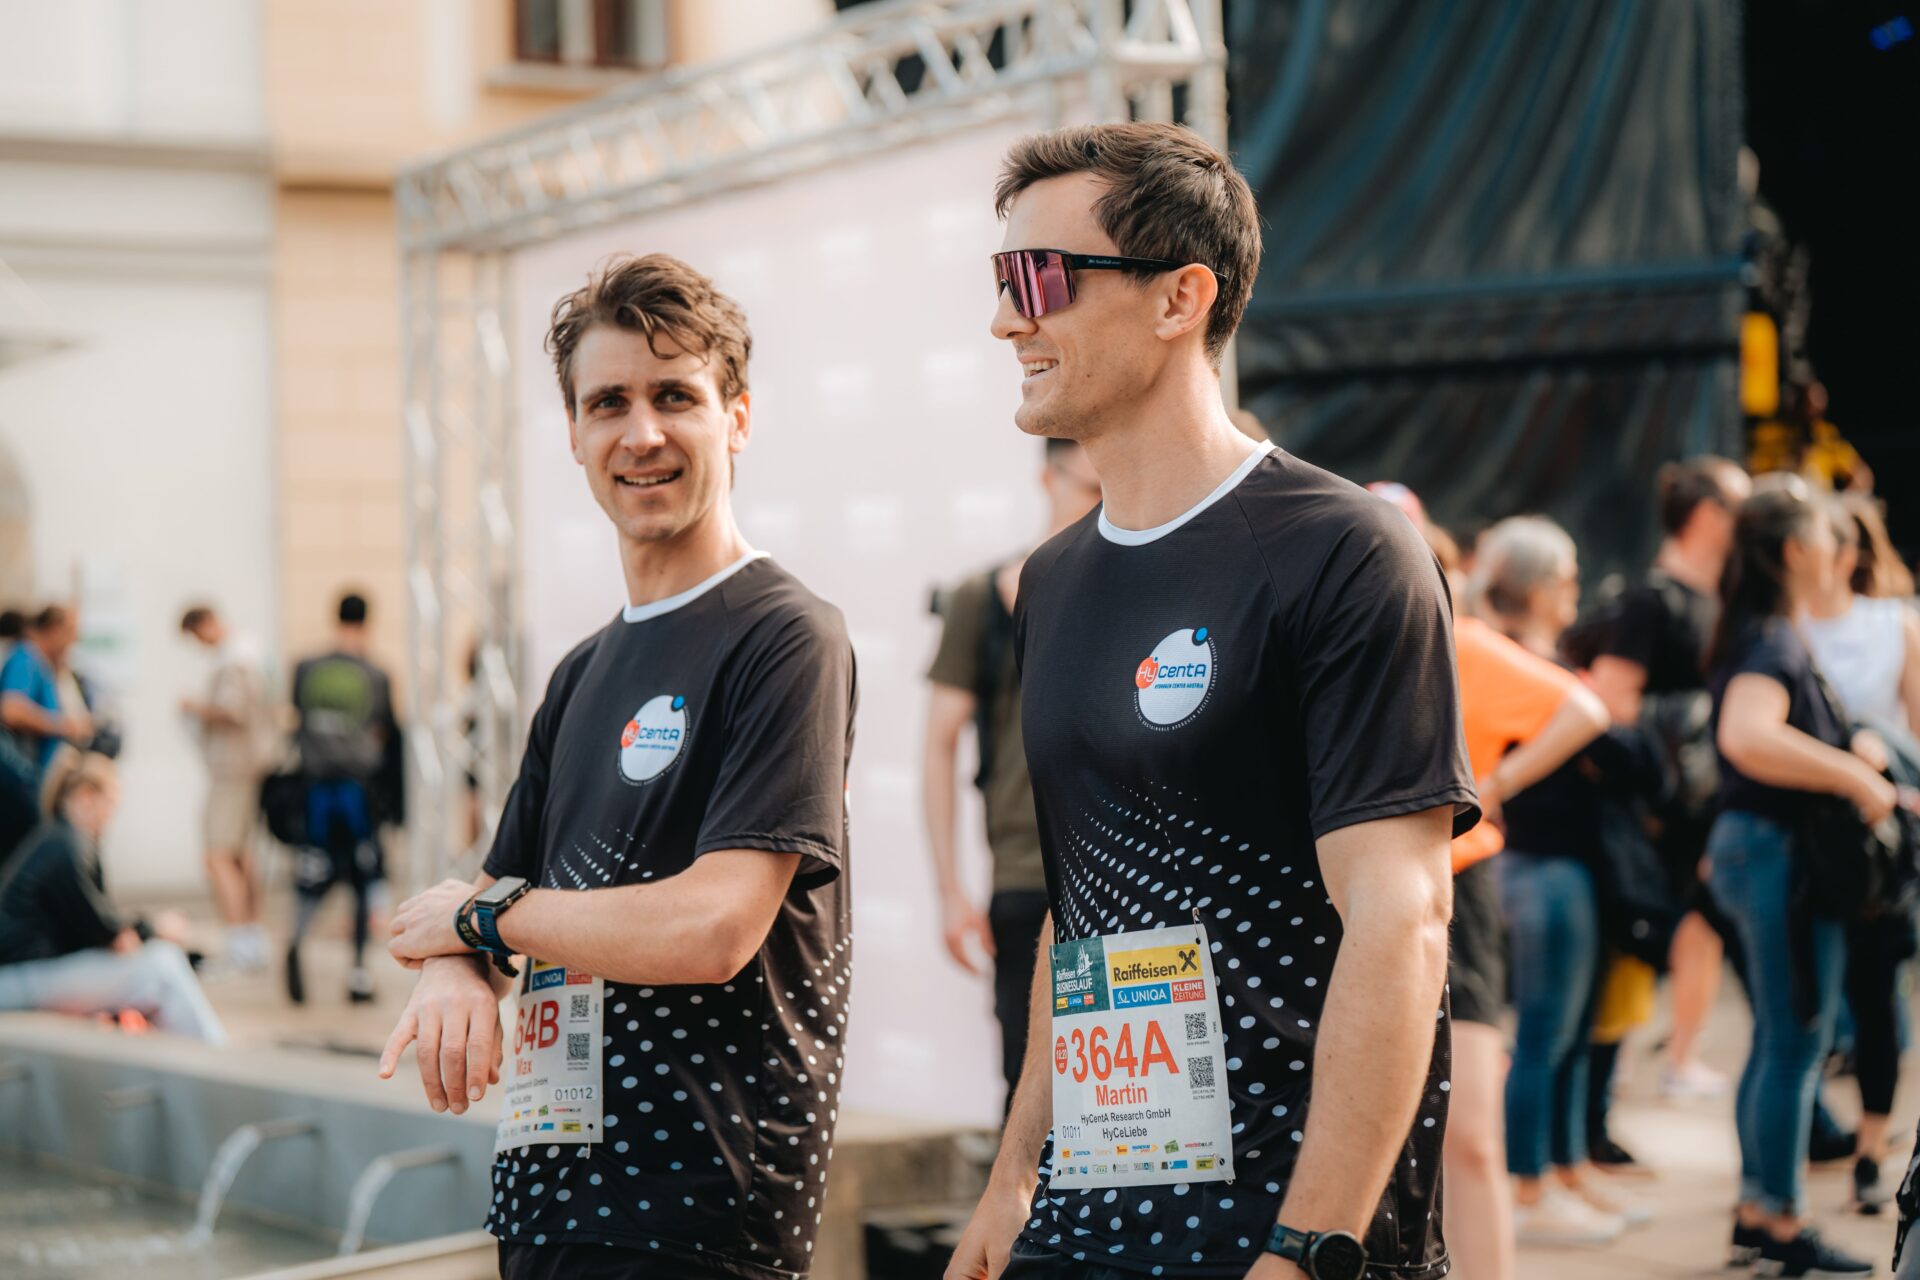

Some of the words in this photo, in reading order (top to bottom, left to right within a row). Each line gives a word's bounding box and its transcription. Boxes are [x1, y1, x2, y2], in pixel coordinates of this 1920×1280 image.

[1113, 962, 1178, 983] Raiffeisen
[1173, 981, 1203, 993] KLEINE
[1131, 990, 1167, 1003] UNIQA
[1174, 990, 1205, 1001] ZEITUNG
[1071, 1020, 1180, 1083] 364A
[555, 1087, 593, 1101] 01012
[1095, 1082, 1148, 1107] Martin
[1080, 1113, 1109, 1126] HyCentA
[1110, 1110, 1144, 1122] Research
[1146, 1108, 1171, 1119] GmbH
[1062, 1125, 1081, 1139] 01011
[1102, 1126, 1148, 1141] HyCeLiebe
